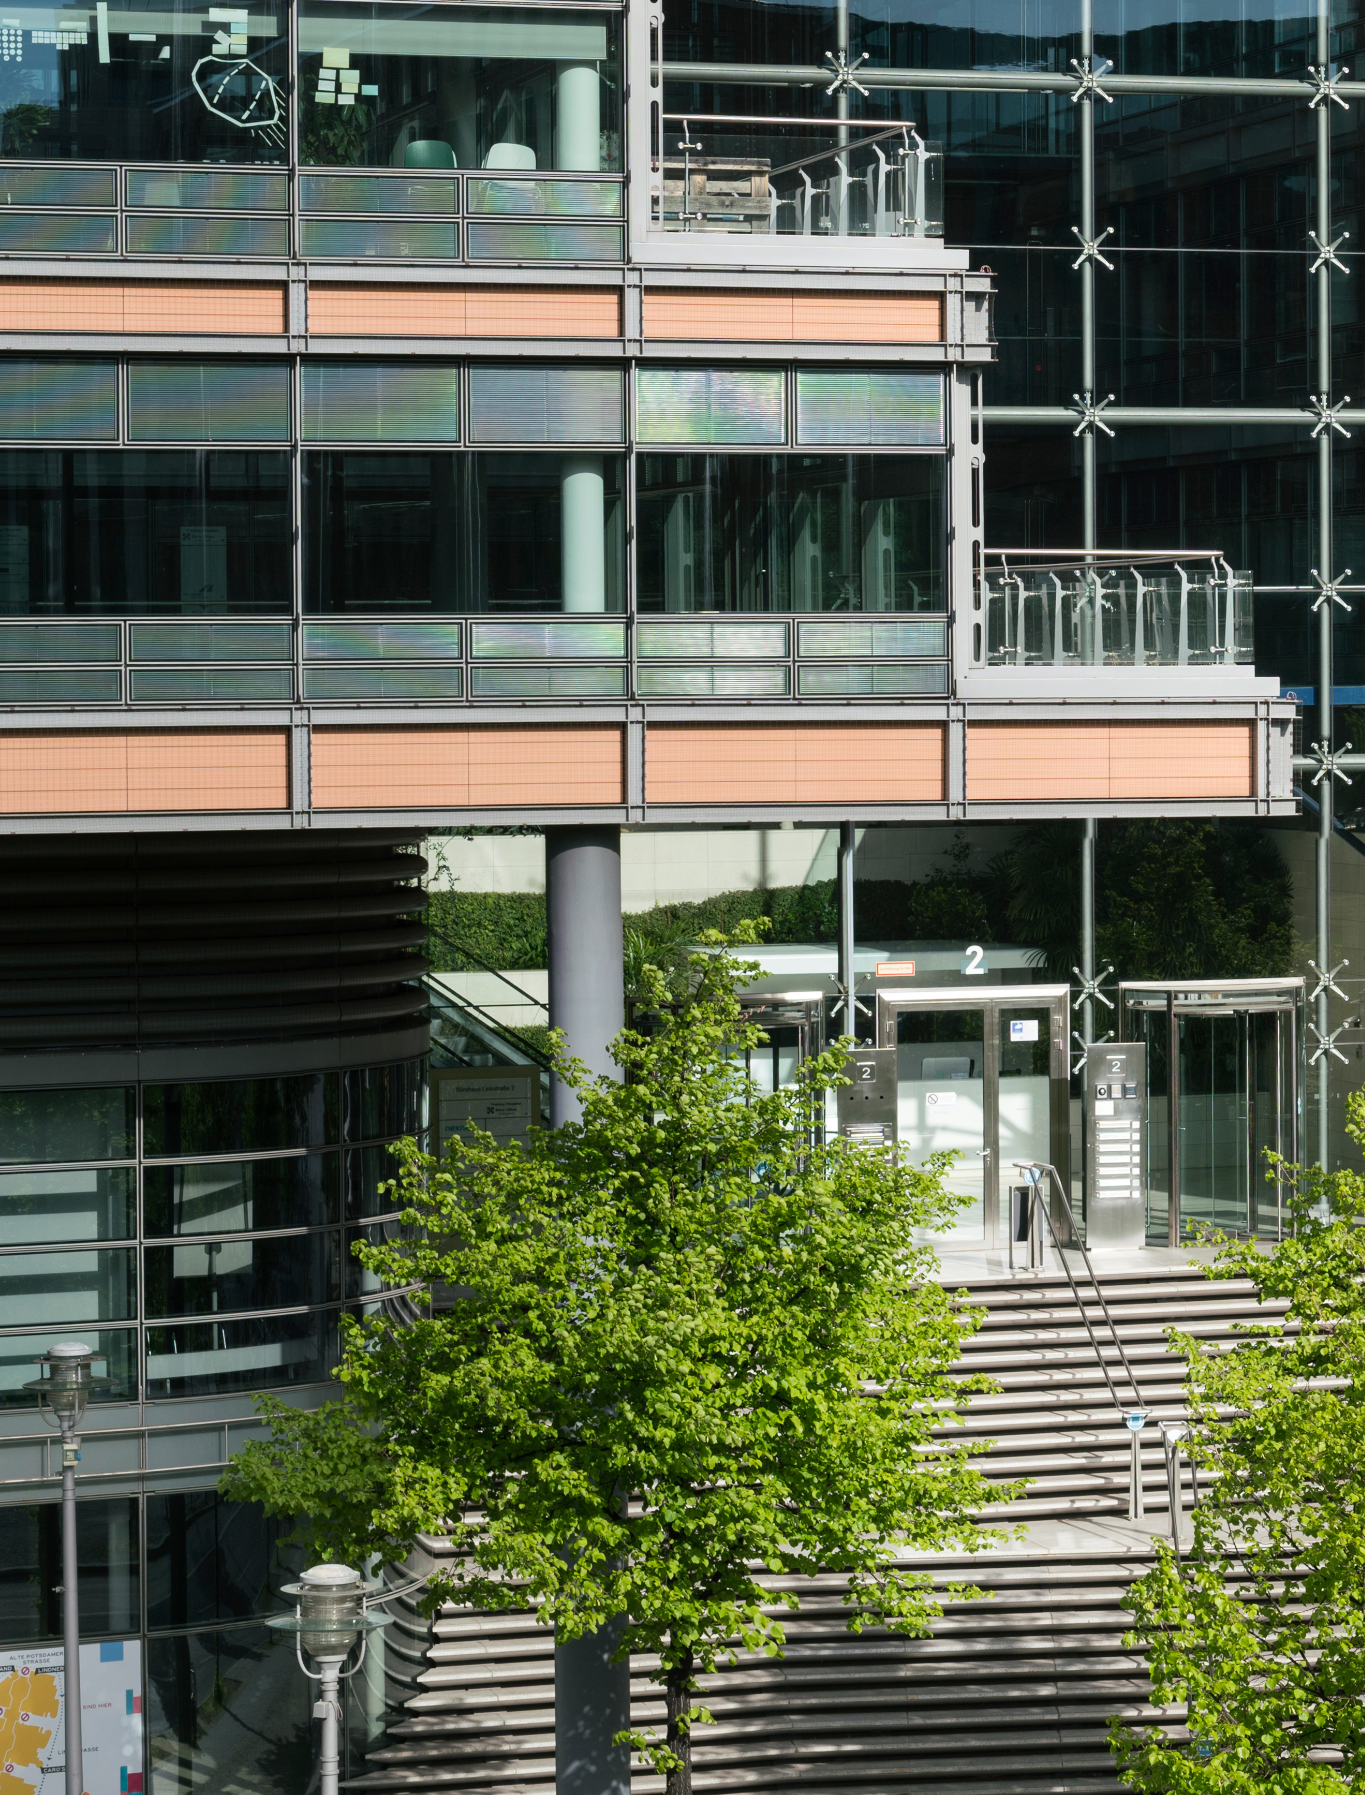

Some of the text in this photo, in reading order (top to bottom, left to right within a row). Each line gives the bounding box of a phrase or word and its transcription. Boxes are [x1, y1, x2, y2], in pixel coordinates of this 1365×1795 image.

[965, 945, 984, 975] 2
[1111, 1061, 1121, 1072] 2
[862, 1067, 871, 1079] 2
[26, 1651, 64, 1659] POTSDAMER
[58, 1747, 99, 1755] LIASSE
